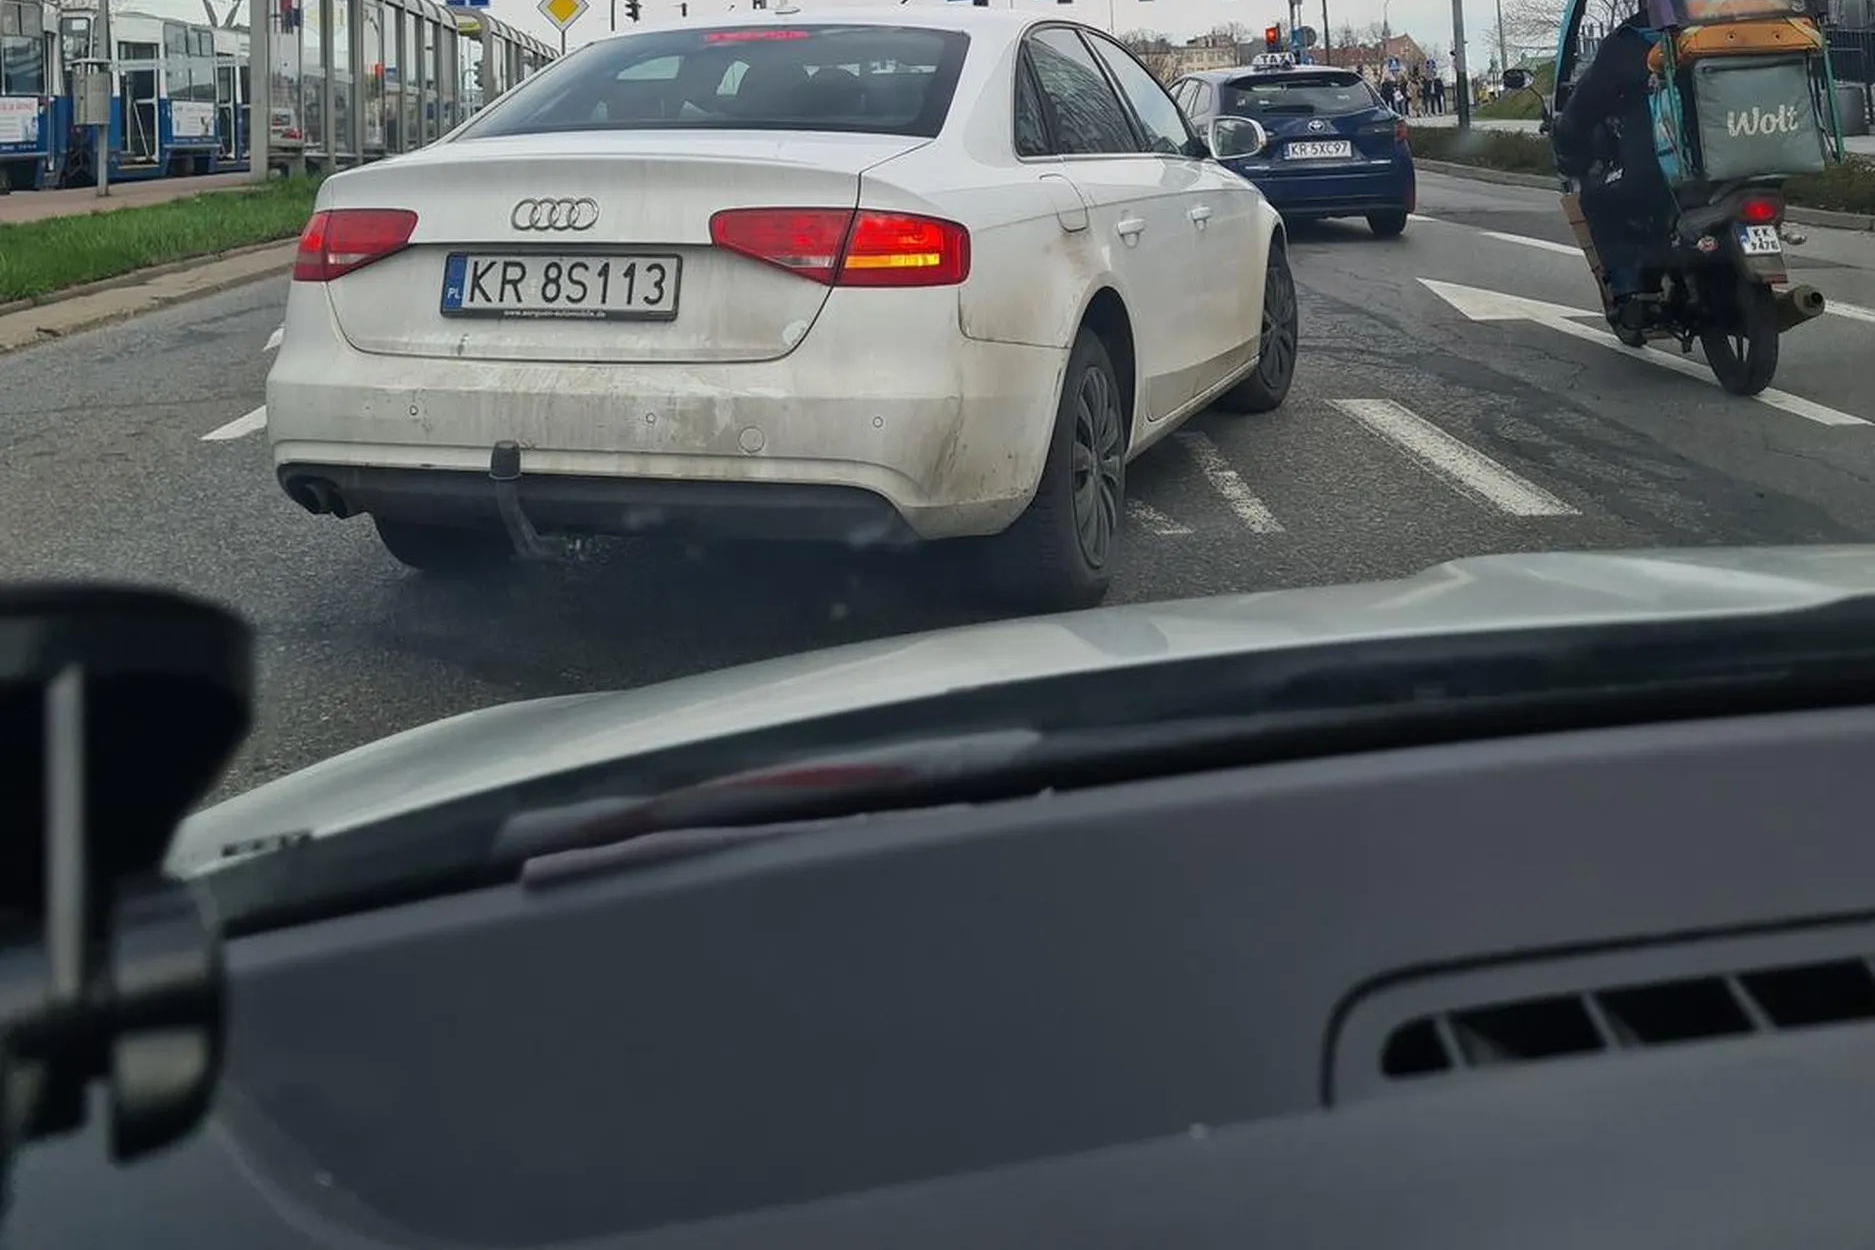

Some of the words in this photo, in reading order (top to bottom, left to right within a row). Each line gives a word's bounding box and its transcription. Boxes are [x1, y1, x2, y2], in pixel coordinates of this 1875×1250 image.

[1260, 54, 1294, 64] TAXI
[1727, 104, 1799, 138] Wolt
[1292, 144, 1308, 156] KR
[1311, 141, 1349, 156] 5XC97
[468, 260, 527, 303] KR
[541, 260, 666, 305] 8S113
[447, 287, 460, 299] PL
